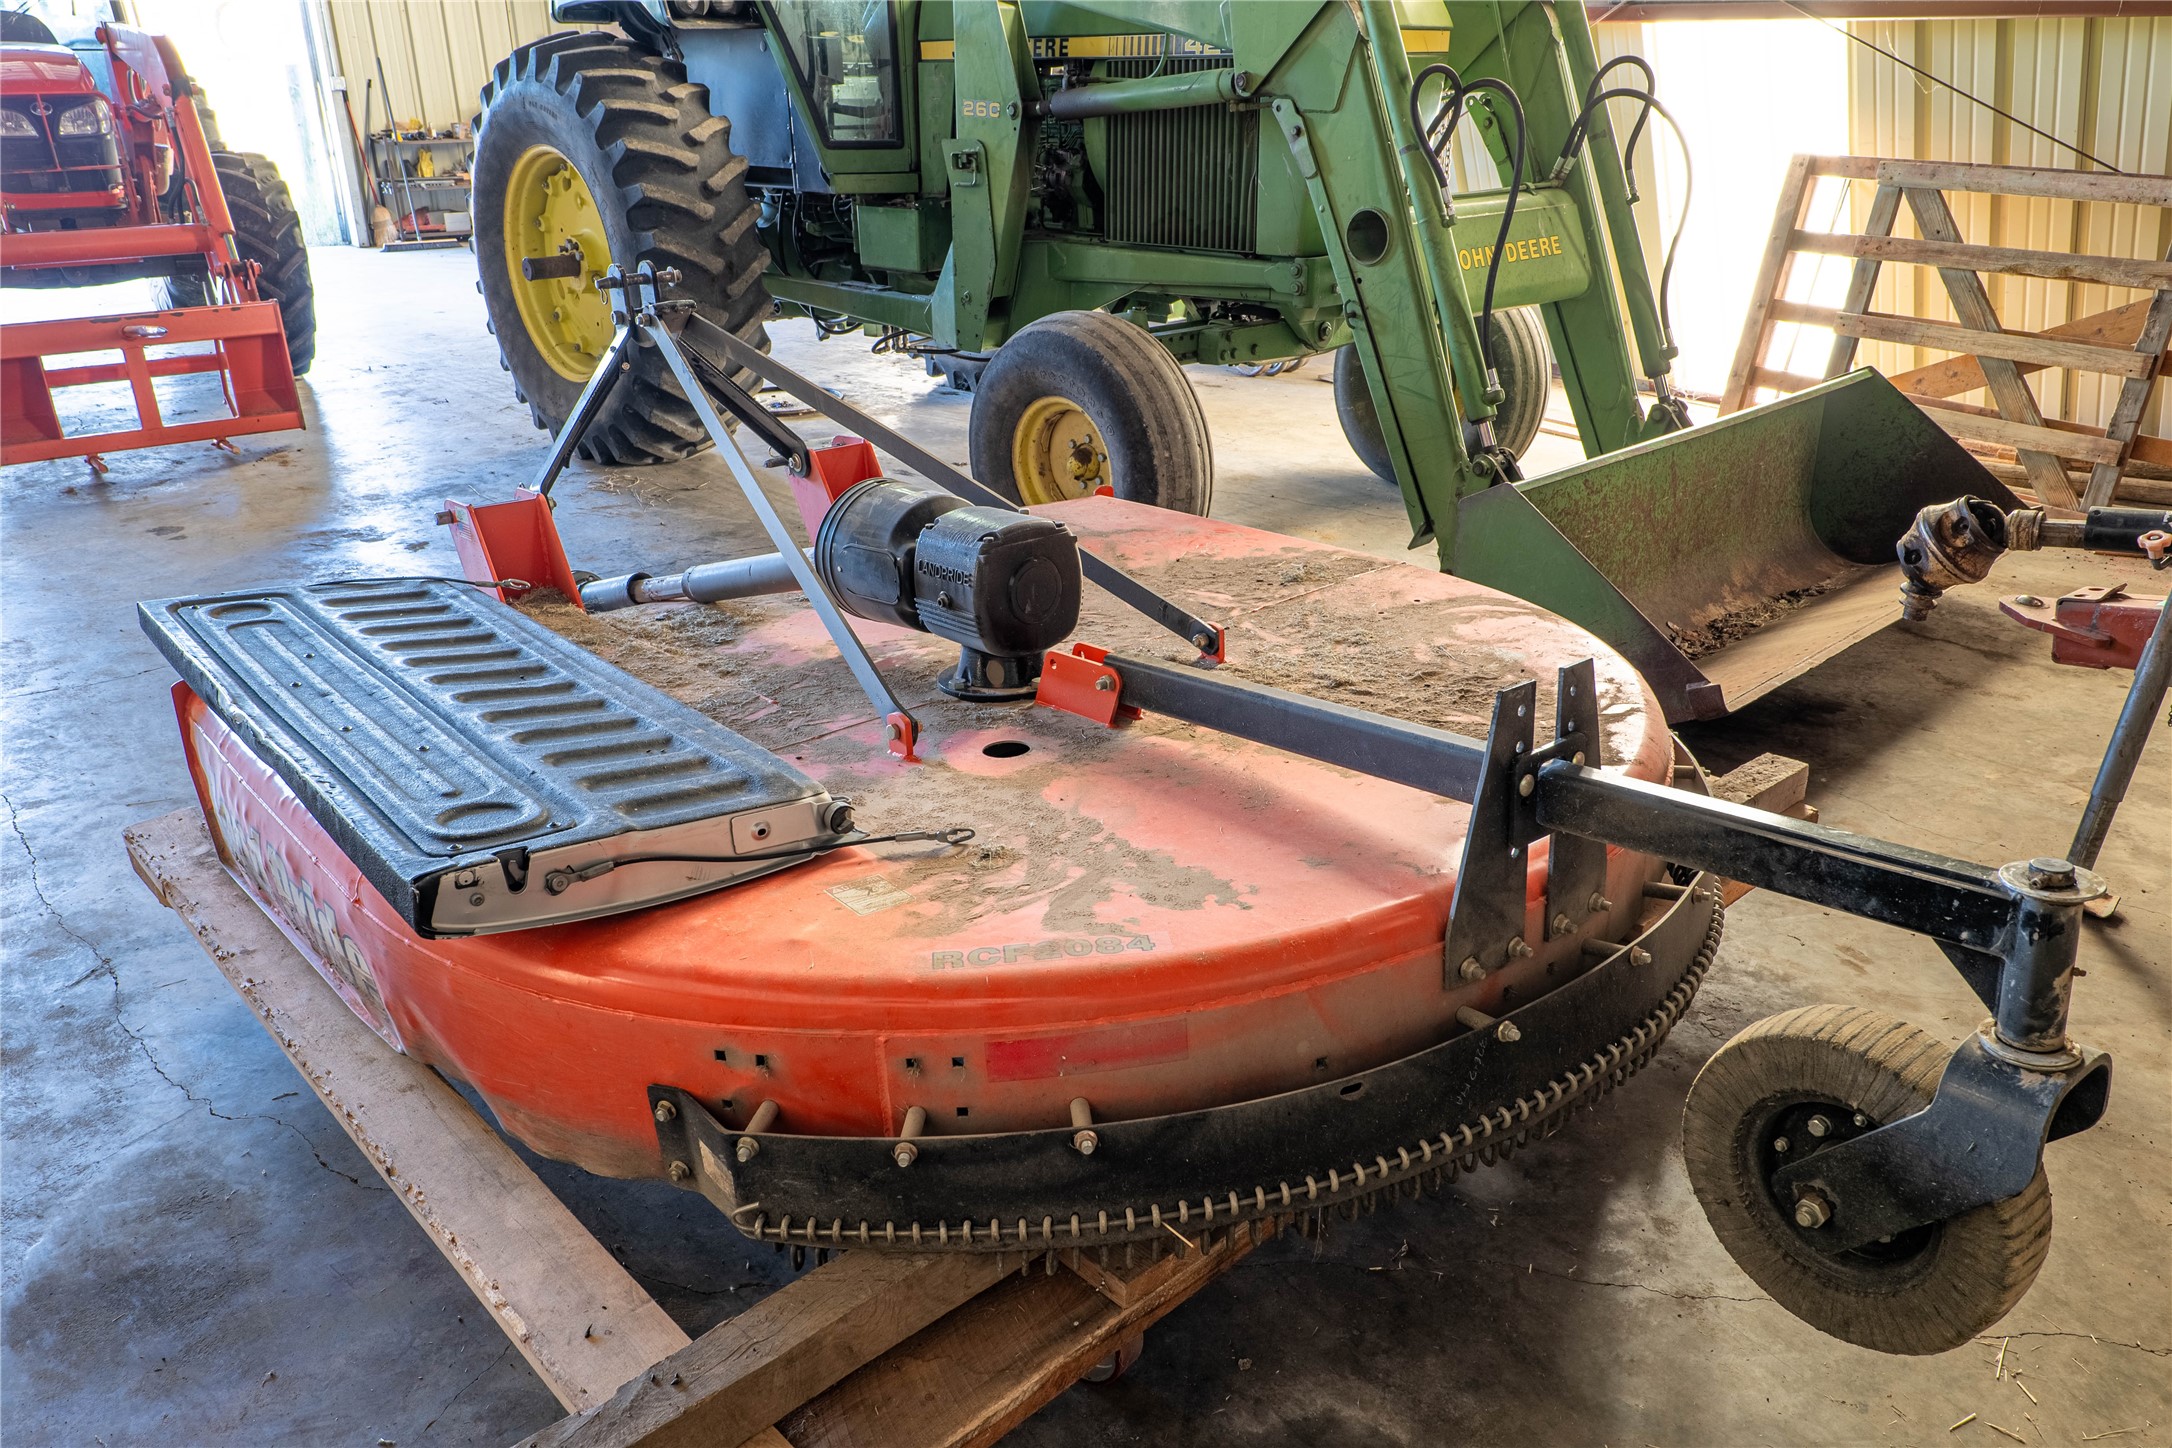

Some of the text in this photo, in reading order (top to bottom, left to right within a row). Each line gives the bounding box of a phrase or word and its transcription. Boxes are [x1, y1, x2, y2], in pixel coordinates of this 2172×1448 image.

[1028, 38, 1069, 57] ERE
[1459, 235, 1562, 271] OHN DEERE
[917, 559, 973, 588] LANDPRIDE
[931, 935, 1156, 970] RCF2084
